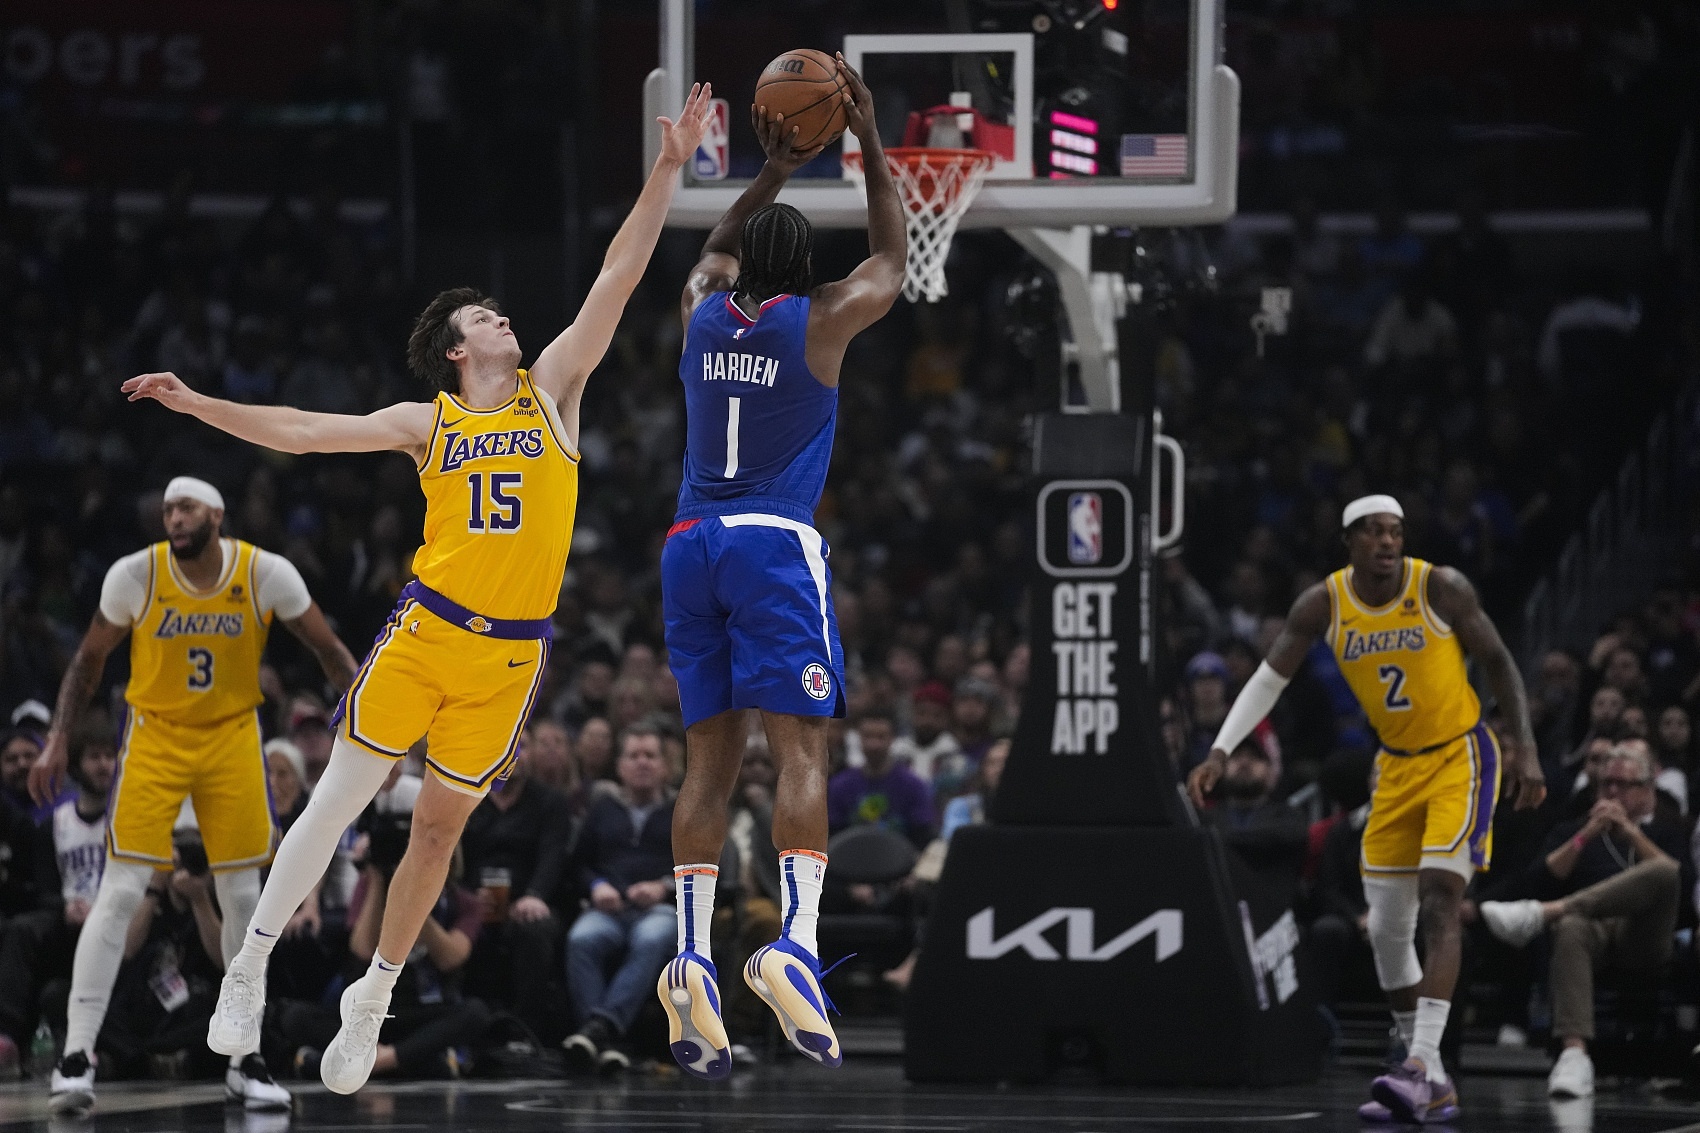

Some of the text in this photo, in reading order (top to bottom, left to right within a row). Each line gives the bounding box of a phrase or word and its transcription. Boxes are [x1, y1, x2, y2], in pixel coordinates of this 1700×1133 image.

[703, 352, 780, 388] HARDEN
[513, 408, 539, 418] bibigo
[724, 396, 741, 479] 1
[439, 428, 545, 474] LAKERS
[467, 471, 523, 535] 15
[153, 608, 243, 640] LAKERS
[1053, 582, 1118, 639] GET
[1342, 624, 1427, 662] LAKERS
[187, 647, 214, 693] 3
[1052, 640, 1118, 697] THE
[1378, 664, 1412, 713] 2
[1051, 698, 1120, 755] APP
[966, 905, 1184, 963] KIA
